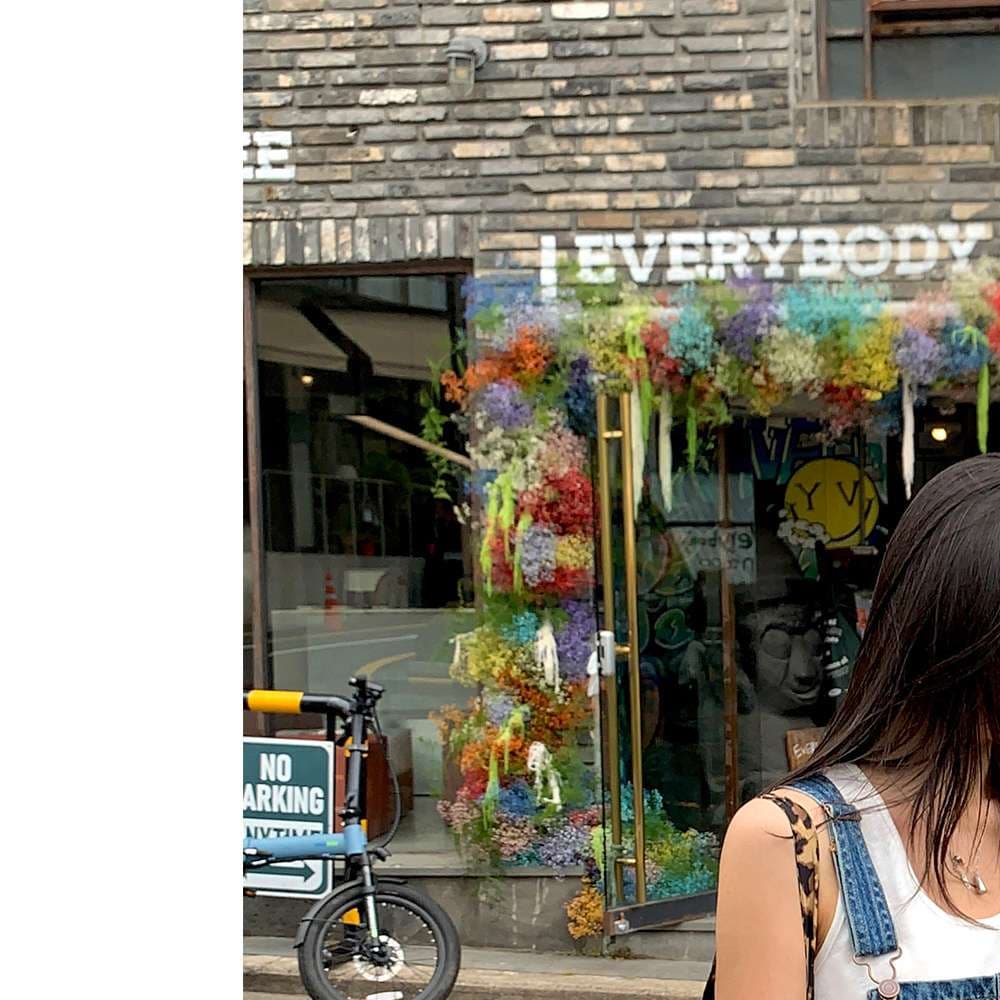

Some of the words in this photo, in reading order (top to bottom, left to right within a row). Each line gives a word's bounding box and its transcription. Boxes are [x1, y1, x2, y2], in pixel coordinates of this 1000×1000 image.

[243, 131, 295, 179] E
[575, 222, 988, 283] EVERYBODY
[259, 753, 292, 782] NO
